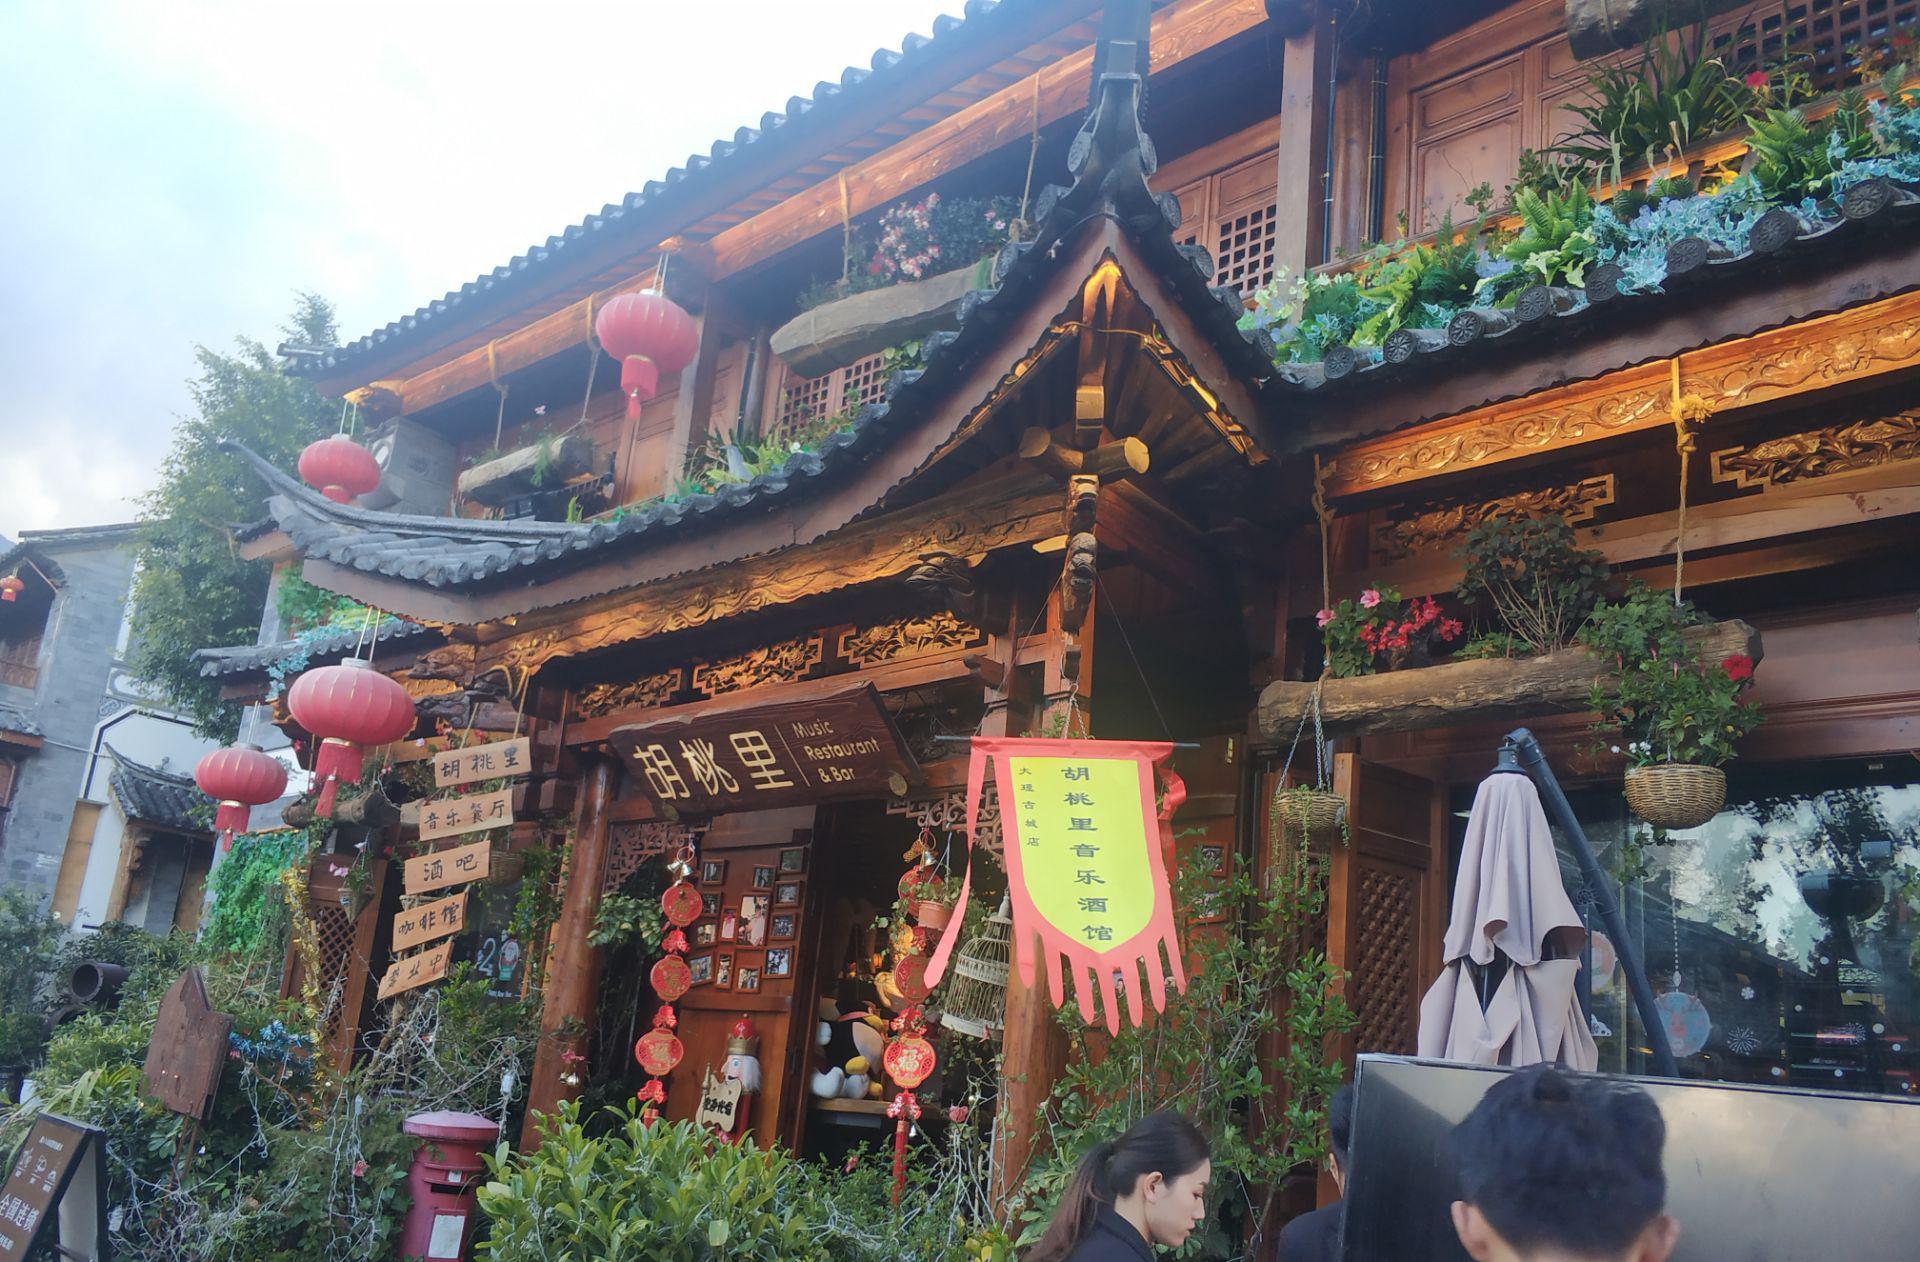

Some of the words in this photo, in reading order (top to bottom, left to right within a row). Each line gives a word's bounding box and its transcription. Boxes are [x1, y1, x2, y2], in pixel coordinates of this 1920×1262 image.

[792, 717, 834, 740] Music
[440, 746, 519, 778] 胡桃里
[633, 730, 794, 800] 胡桃里
[804, 736, 881, 762] Restaurant
[818, 767, 831, 784] &
[832, 766, 856, 783] Bar
[424, 799, 505, 831] 音乐餐厅
[1018, 767, 1041, 847] 大理古城店
[423, 853, 479, 882] 酒吧
[1061, 767, 1113, 941] 胡桃里音乐酒馆
[398, 902, 460, 935] 咖啡馆
